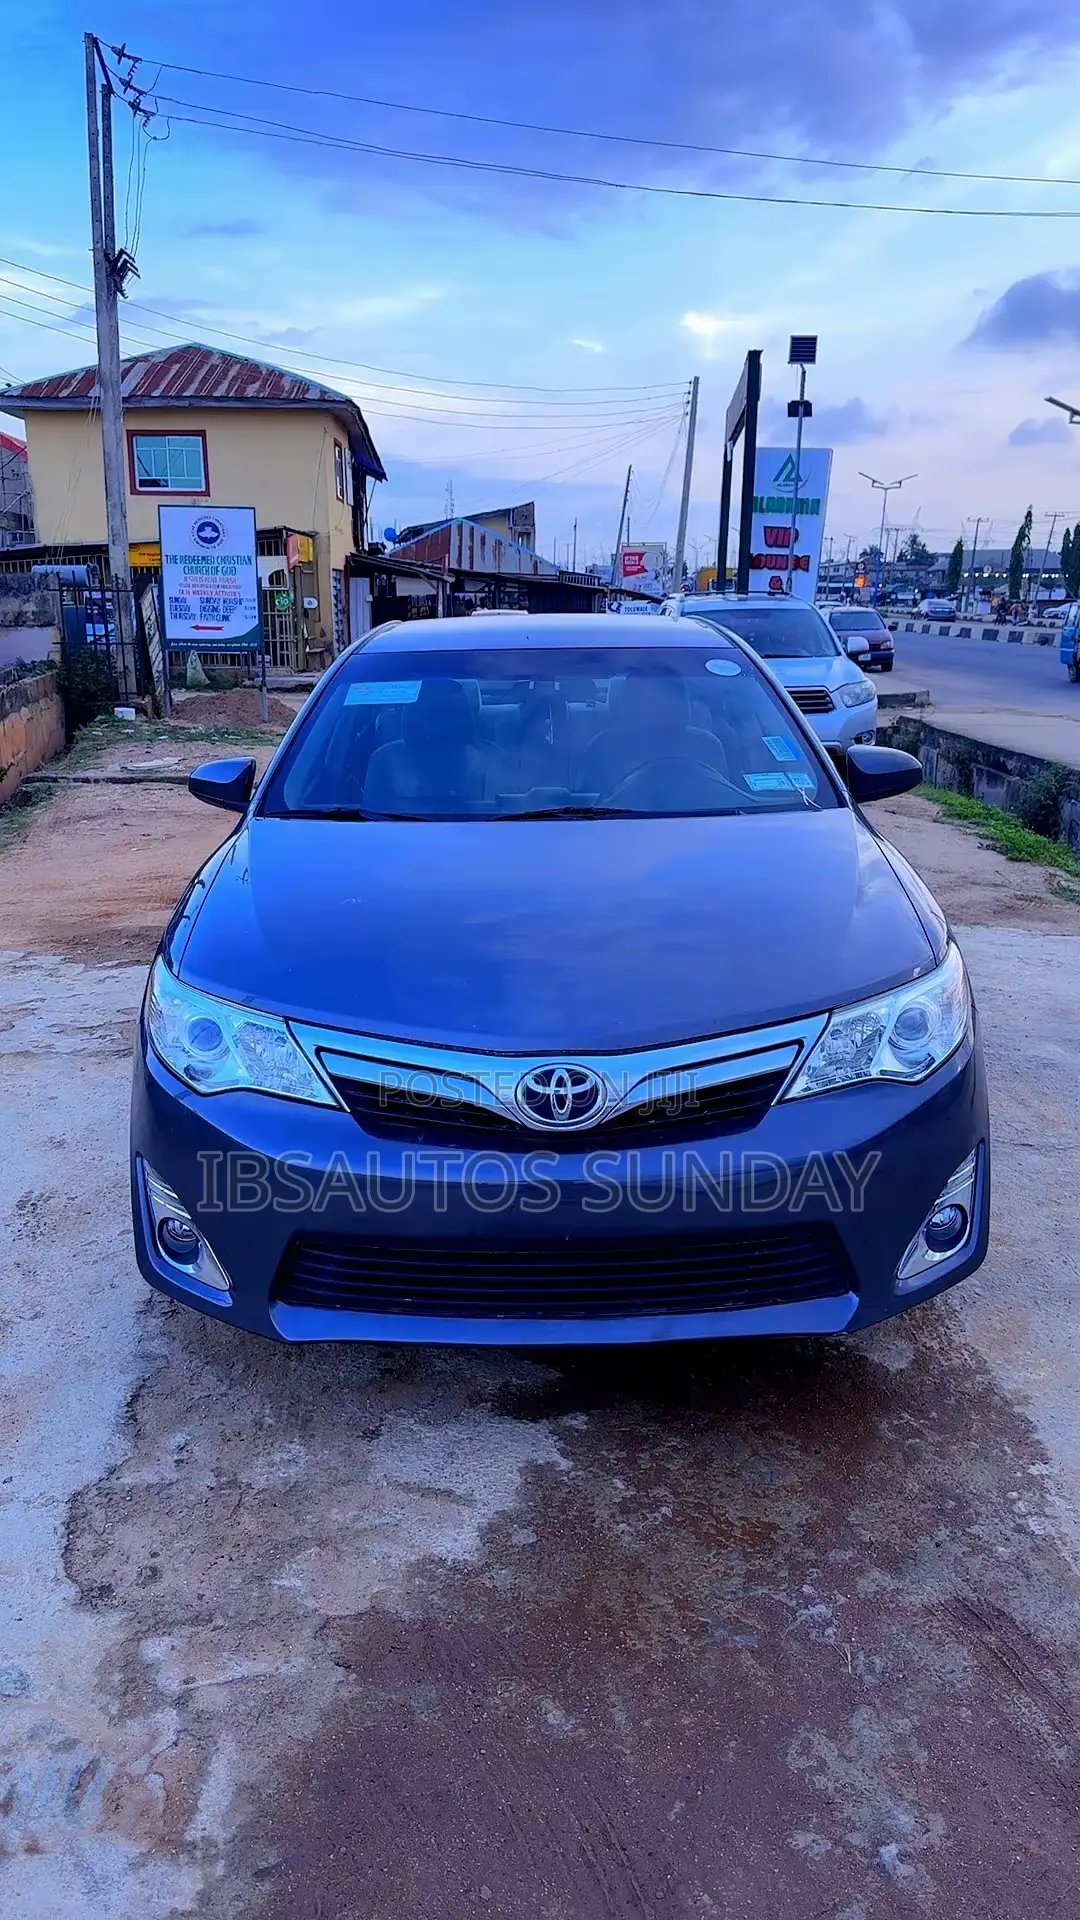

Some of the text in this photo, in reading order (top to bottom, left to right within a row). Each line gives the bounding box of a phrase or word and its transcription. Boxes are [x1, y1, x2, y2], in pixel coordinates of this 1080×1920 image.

[165, 555, 252, 565] THE REDEEMED CHRISTIAN
[183, 565, 237, 576] CHURCH OF GOD
[168, 596, 187, 604] SUNDAY
[222, 606, 237, 614] DEEP
